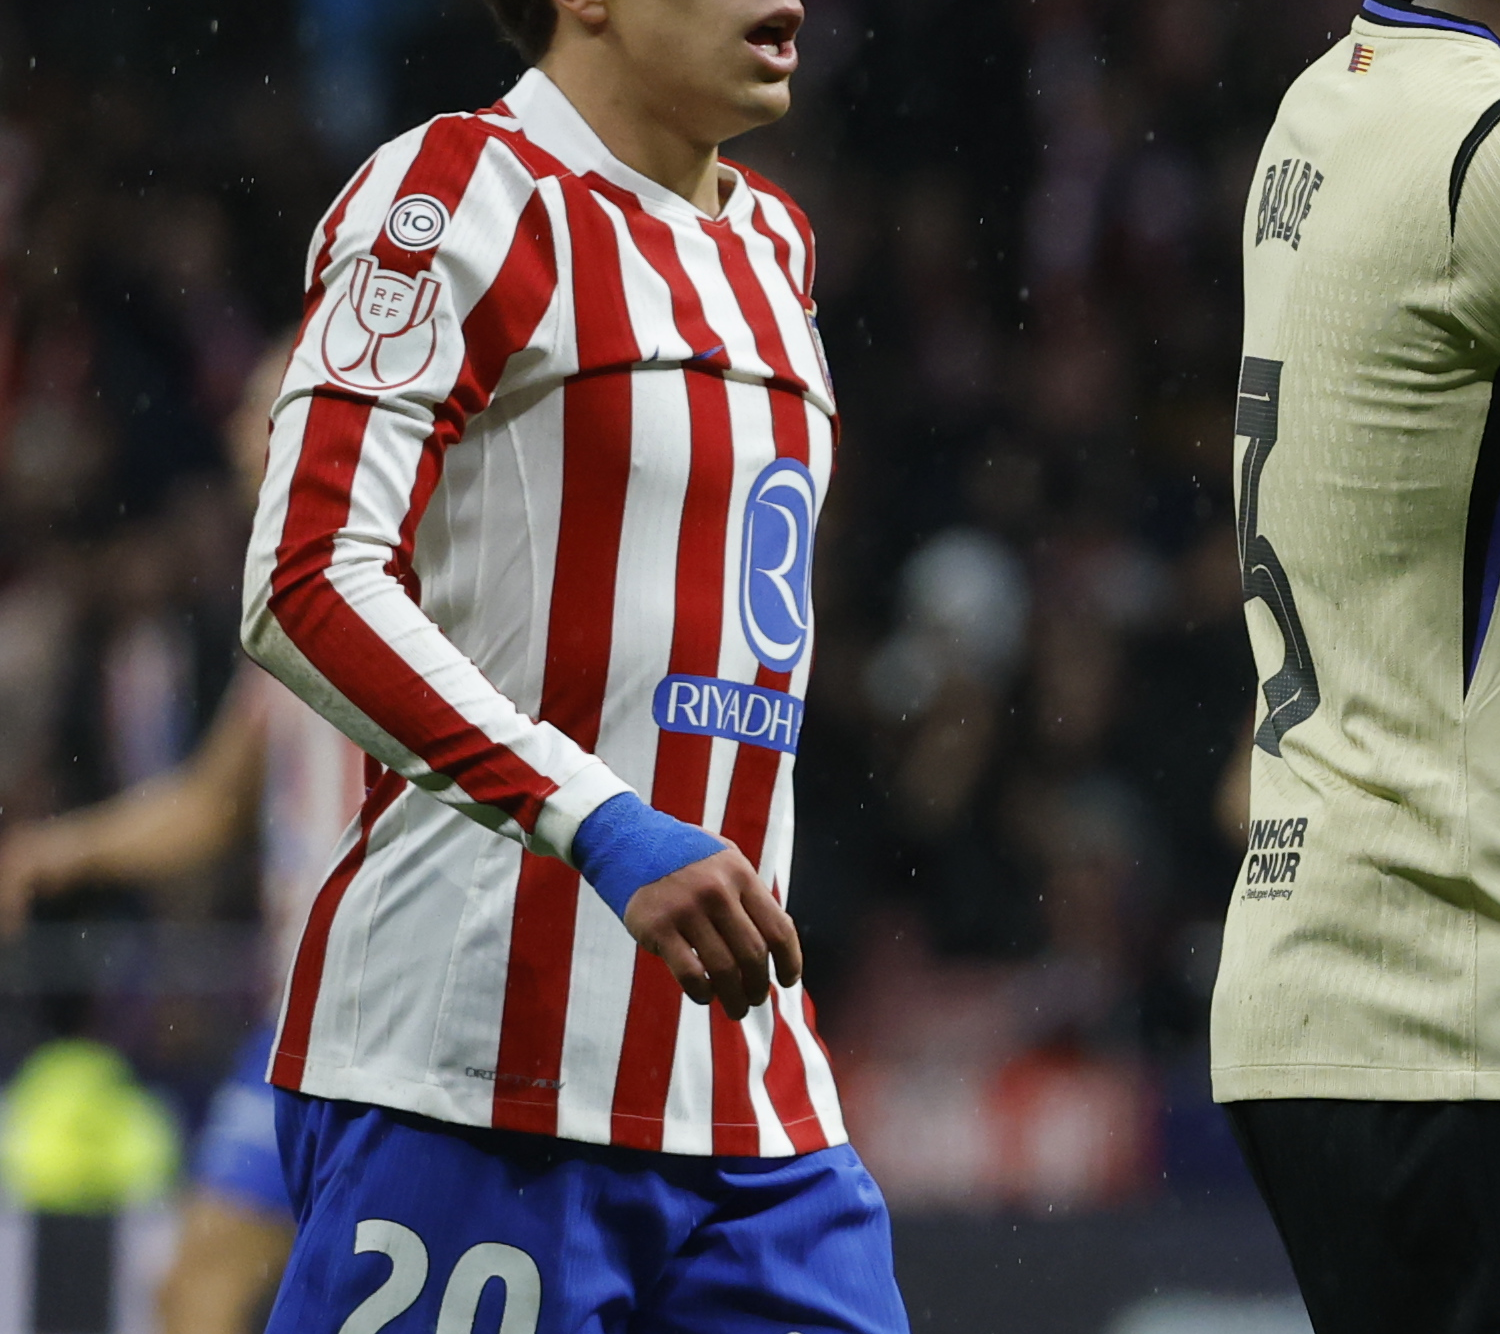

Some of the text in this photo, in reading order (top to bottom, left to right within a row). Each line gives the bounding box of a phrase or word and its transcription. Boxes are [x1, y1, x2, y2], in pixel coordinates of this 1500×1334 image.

[402, 211, 435, 232] 10
[1255, 158, 1325, 252] BALDE
[666, 681, 794, 745] RIYADH
